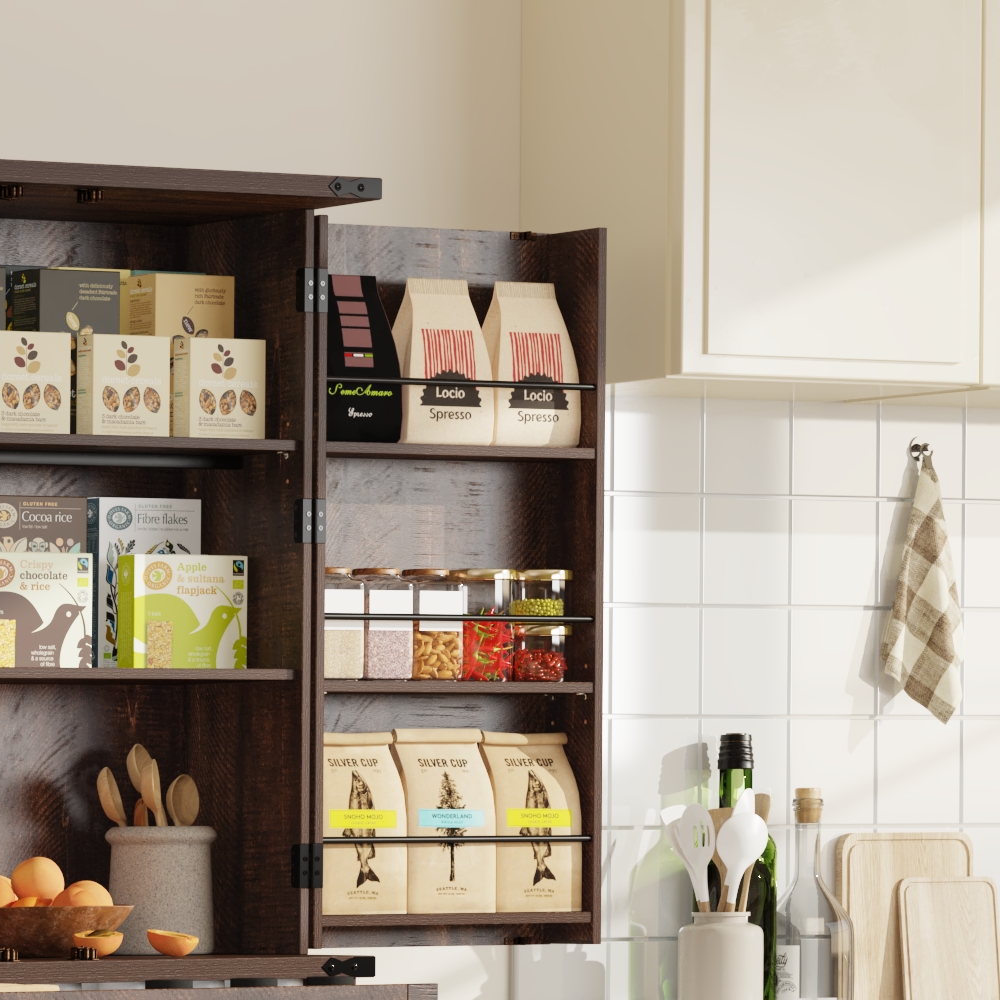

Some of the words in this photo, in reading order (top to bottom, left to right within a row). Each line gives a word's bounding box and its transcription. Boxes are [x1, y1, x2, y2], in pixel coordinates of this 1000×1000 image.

[1, 372, 30, 381] dorset
[30, 373, 63, 383] cereals
[101, 375, 130, 384] dorset
[131, 376, 162, 385] cereals
[198, 379, 226, 388] dorset
[227, 380, 258, 388] cereals
[435, 386, 466, 399] Locio
[523, 388, 553, 402] Locio
[429, 407, 472, 422] Spresso
[517, 410, 560, 424] Spresso
[22, 511, 52, 522] Cocoa
[55, 512, 73, 523] rice
[137, 513, 160, 524] Fibre
[162, 513, 188, 525] flakes
[108, 519, 131, 530] ORGANIC
[20, 560, 53, 571] Crispy
[177, 562, 207, 573] Apple
[20, 571, 68, 580] chocolate
[177, 575, 185, 583] &
[188, 574, 225, 583] sultana
[20, 582, 28, 590] &
[30, 582, 50, 591] rice
[177, 586, 217, 596] flapjack
[328, 759, 358, 767] SILVER
[359, 759, 378, 767] CUP
[418, 759, 448, 767] SILVER
[449, 759, 468, 767] CUP
[505, 758, 535, 767] SILVER
[536, 758, 554, 767] CUP
